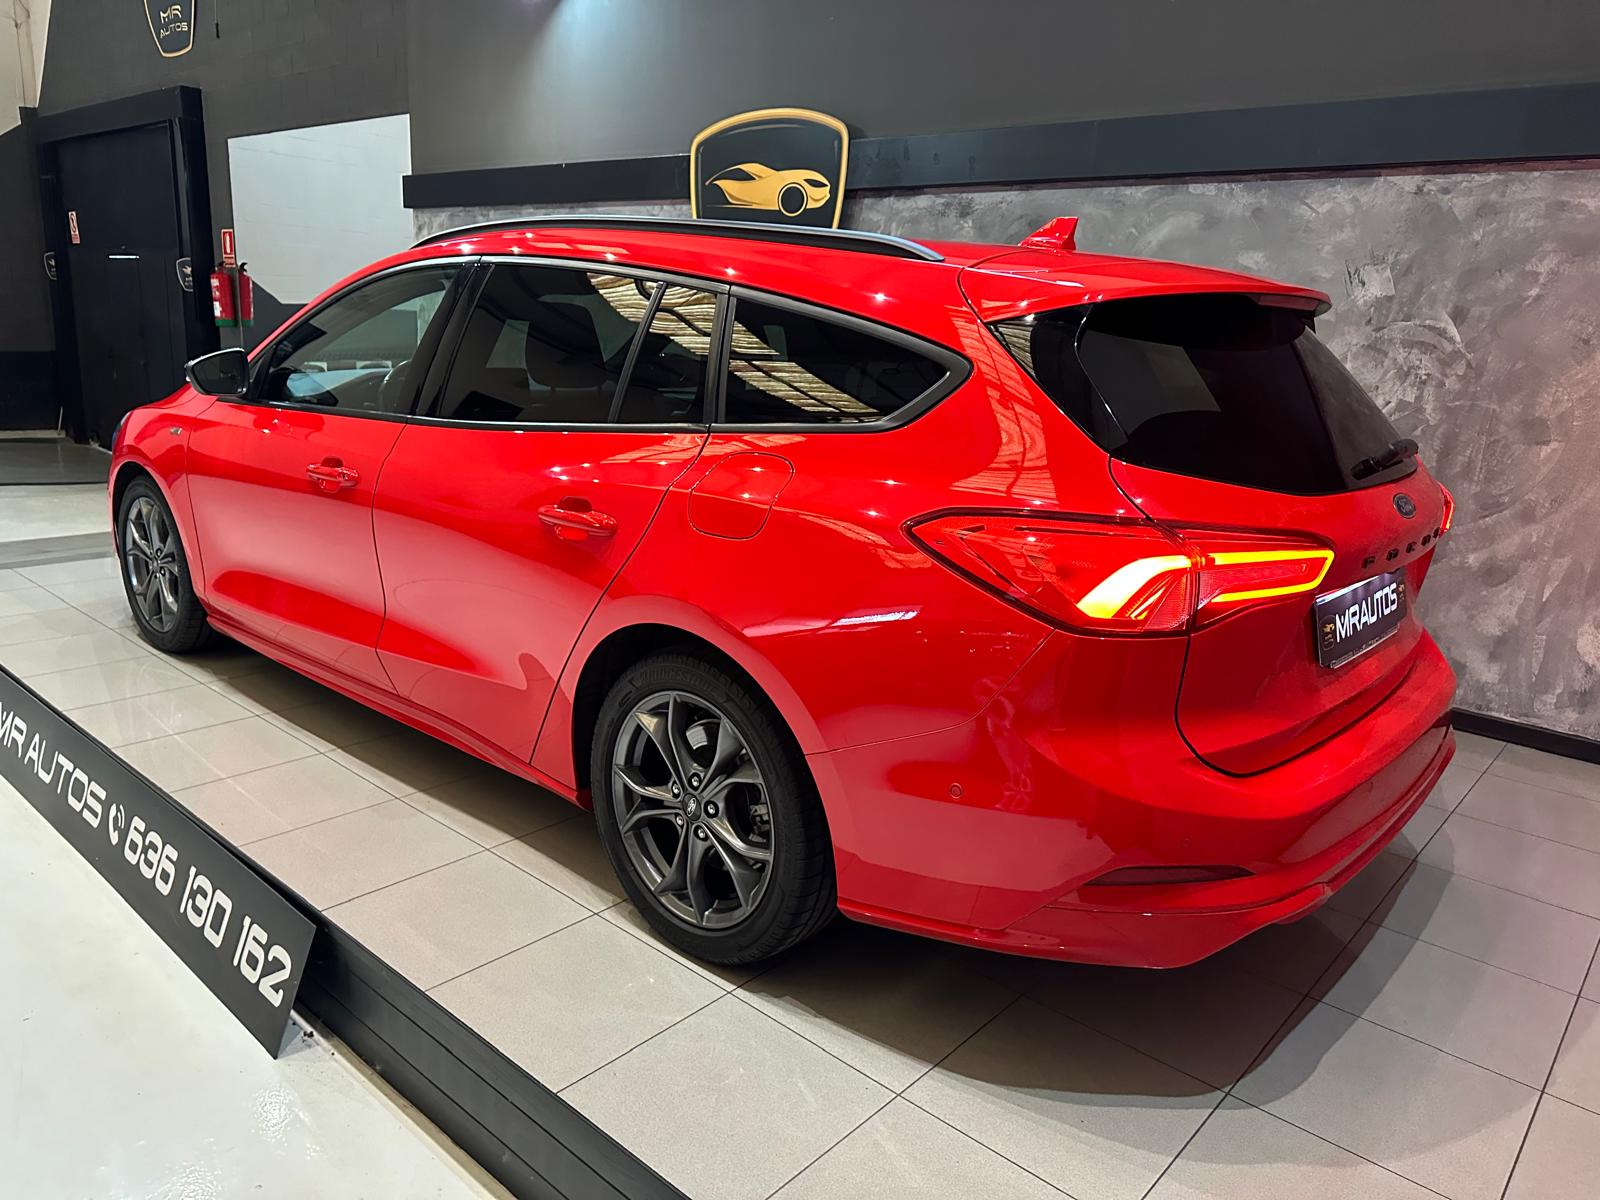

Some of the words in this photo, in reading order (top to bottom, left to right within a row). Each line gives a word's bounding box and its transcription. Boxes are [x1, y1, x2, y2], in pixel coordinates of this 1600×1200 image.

[160, 5, 181, 23] MR
[160, 22, 188, 38] AUTOS
[1335, 582, 1398, 643] MRAUTOS
[24, 732, 107, 829] AUTOS
[123, 815, 178, 896] 636
[179, 866, 233, 948] 130
[232, 915, 292, 1008] 162
